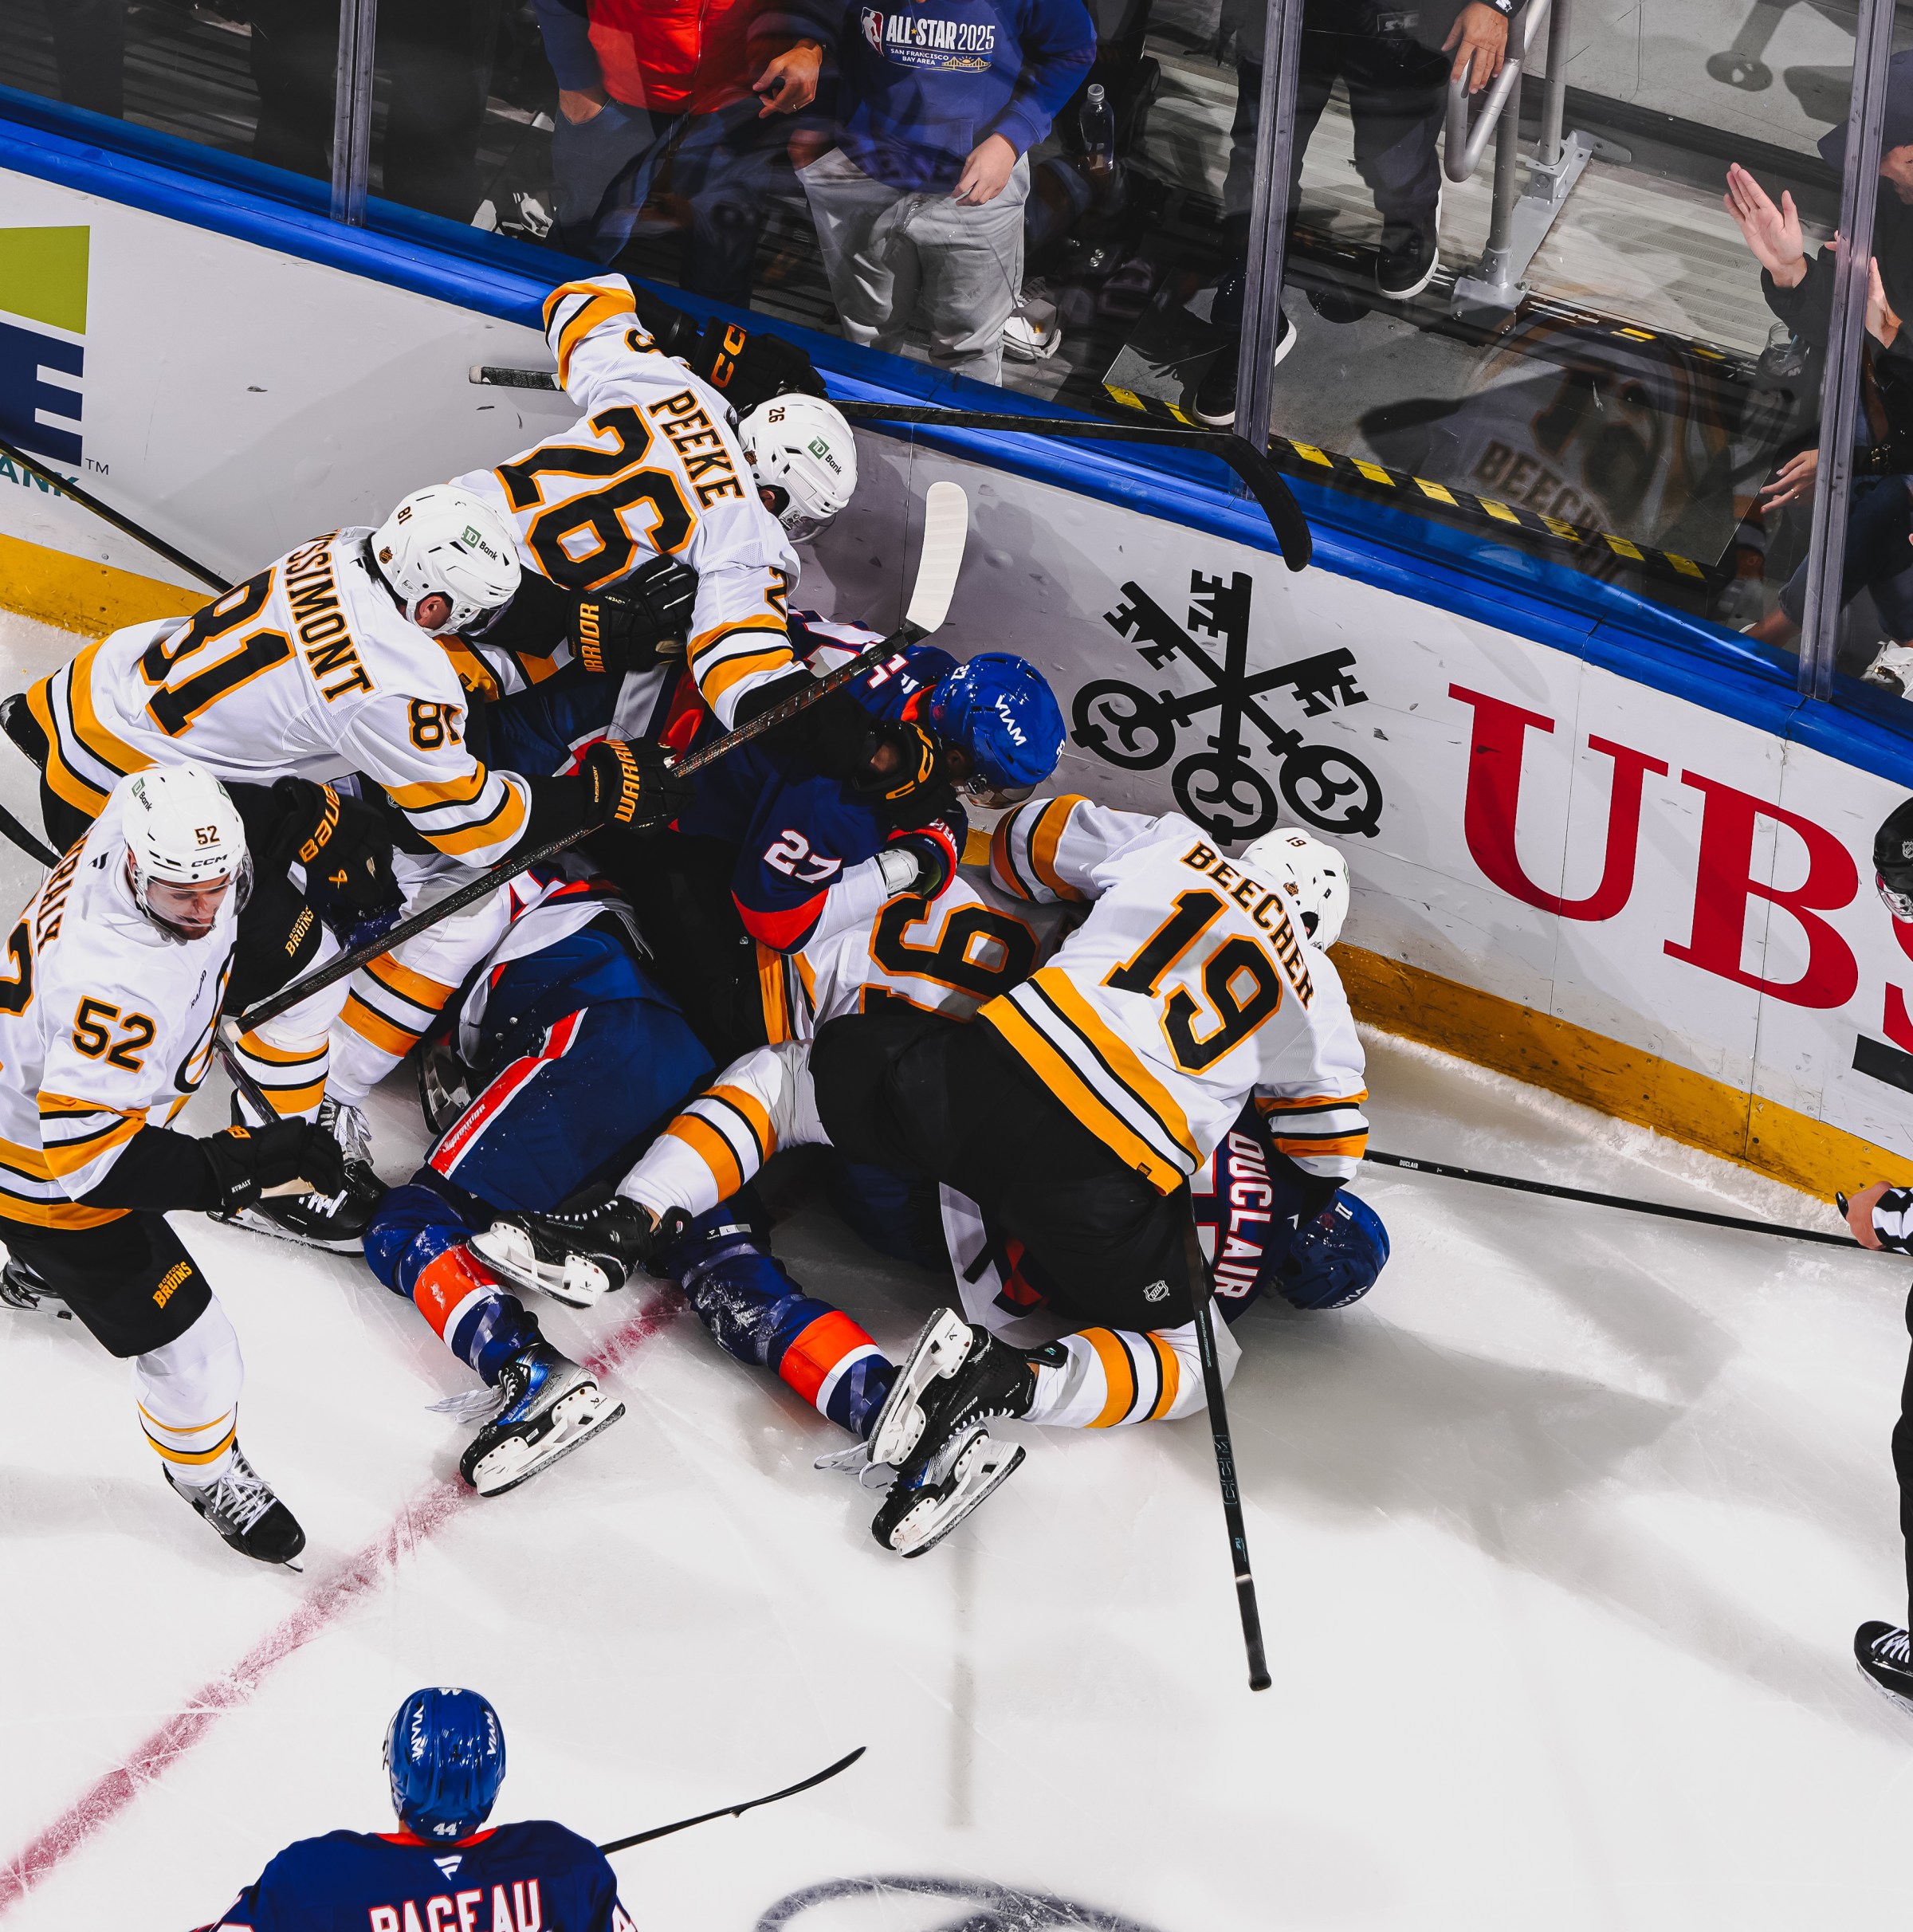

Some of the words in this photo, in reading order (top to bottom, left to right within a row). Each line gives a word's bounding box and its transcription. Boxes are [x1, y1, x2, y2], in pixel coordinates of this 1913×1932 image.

[886, 15, 912, 44] ALL
[916, 18, 957, 49] STAR
[957, 23, 996, 51] 2025
[906, 50, 949, 61] FRANCISCO
[710, 322, 748, 388] CC
[768, 406, 785, 423] 26
[85, 457, 109, 475] TM
[646, 388, 746, 510] PEEKE
[825, 454, 842, 475] Bank
[398, 506, 413, 525] 81
[493, 404, 698, 591] 26
[479, 541, 498, 561] Bank
[284, 528, 375, 703] YSSIMONT
[138, 567, 297, 738] 81
[580, 603, 606, 673] RRIOR
[407, 697, 462, 752] 81
[995, 695, 1027, 747] VIAM
[139, 791, 152, 811] Bank
[601, 739, 640, 823] WARRIO
[194, 825, 220, 846] 52
[299, 783, 340, 863] BAUE
[1286, 837, 1307, 847] 19
[191, 854, 228, 867] CCM
[763, 828, 842, 884] 27
[285, 907, 314, 957] BRUINS
[289, 909, 308, 938] BOSTON
[1180, 840, 1314, 1011] BEECHER
[1099, 888, 1283, 1076] 19
[71, 995, 157, 1074] 52
[1399, 1159, 1419, 1169] DUCLAIR
[231, 1179, 251, 1194] KURALY
[1213, 1131, 1274, 1298] DUCLAIR
[152, 1261, 192, 1309] BRUINS
[158, 1263, 180, 1289] BOSTON
[949, 1396, 978, 1427] BAUER
[433, 1822, 458, 1836] 44
